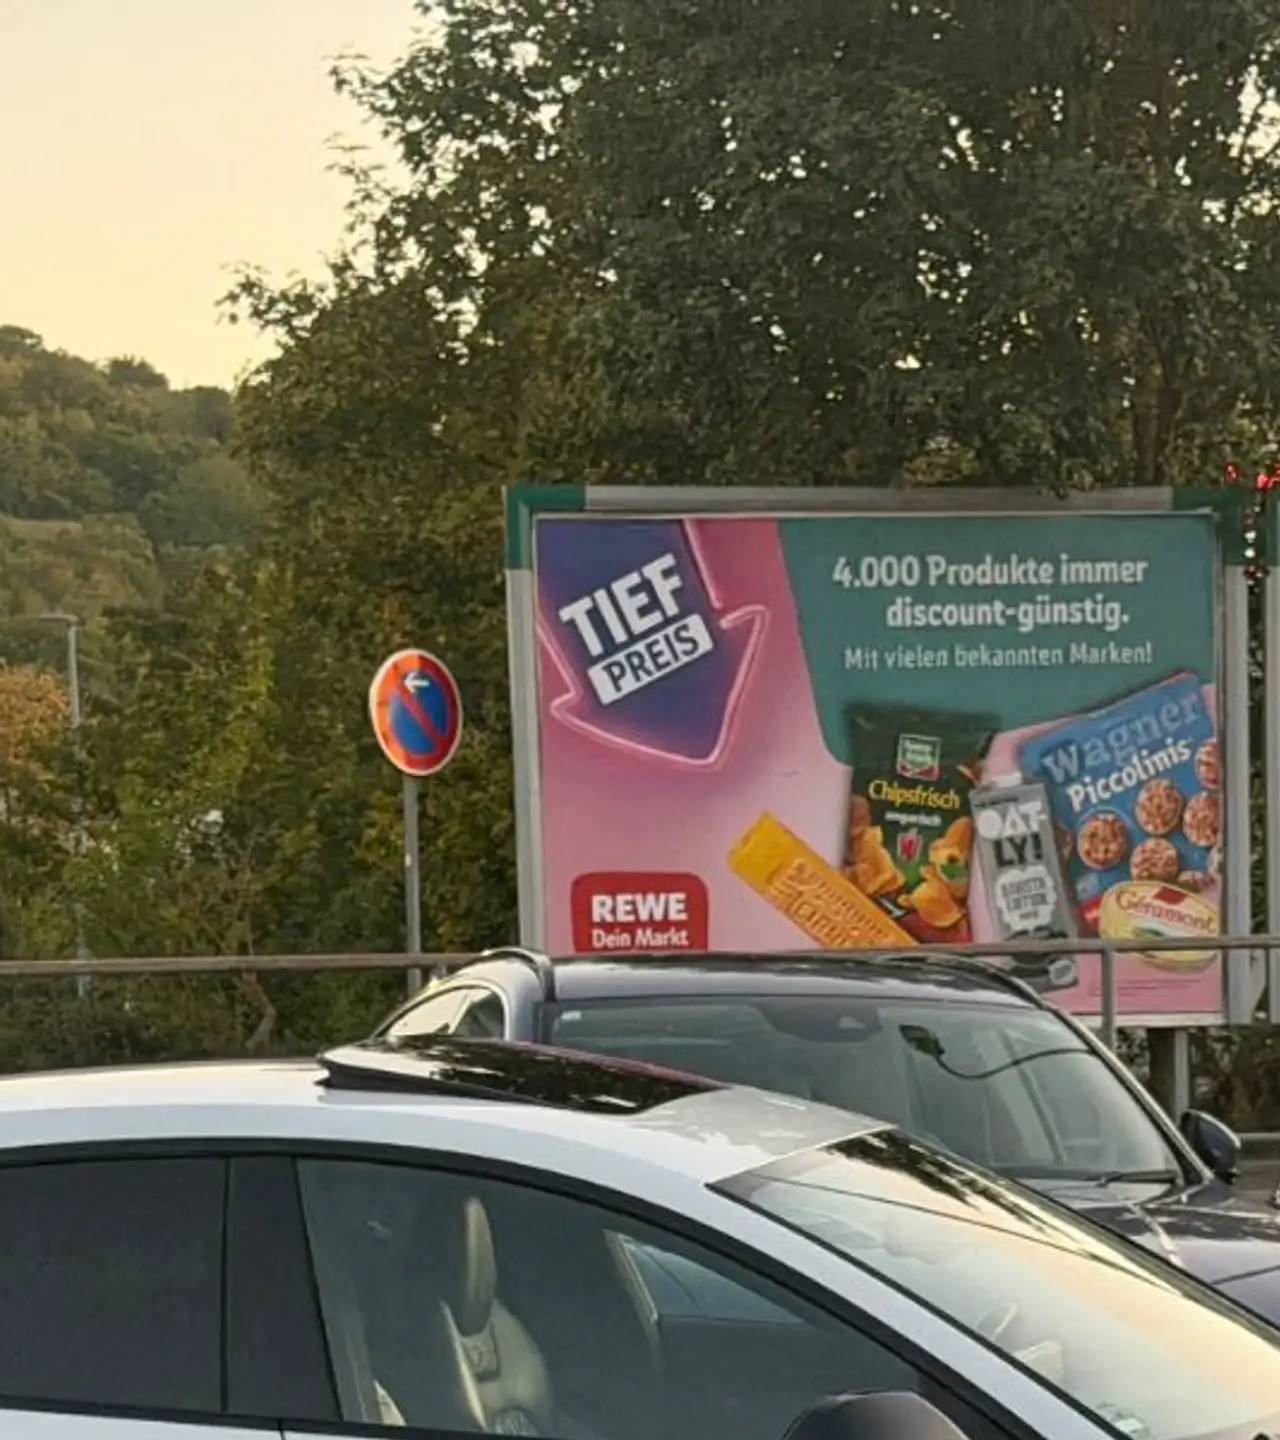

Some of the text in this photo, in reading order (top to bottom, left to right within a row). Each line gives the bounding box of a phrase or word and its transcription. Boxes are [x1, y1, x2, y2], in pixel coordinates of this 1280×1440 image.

[832, 553, 1149, 588] 4.000 Produkte immer
[558, 552, 683, 657] TIEF
[886, 594, 1130, 632] discount-günstig.
[602, 623, 699, 693] PREIS
[845, 641, 1153, 670] Mit vielen bekannten Marken!
[1040, 691, 1201, 784] Wagner
[1066, 738, 1195, 812] Piccolinis
[992, 832, 1043, 868] LY!
[591, 892, 688, 922] REWE
[592, 926, 689, 948] Dein Markt
